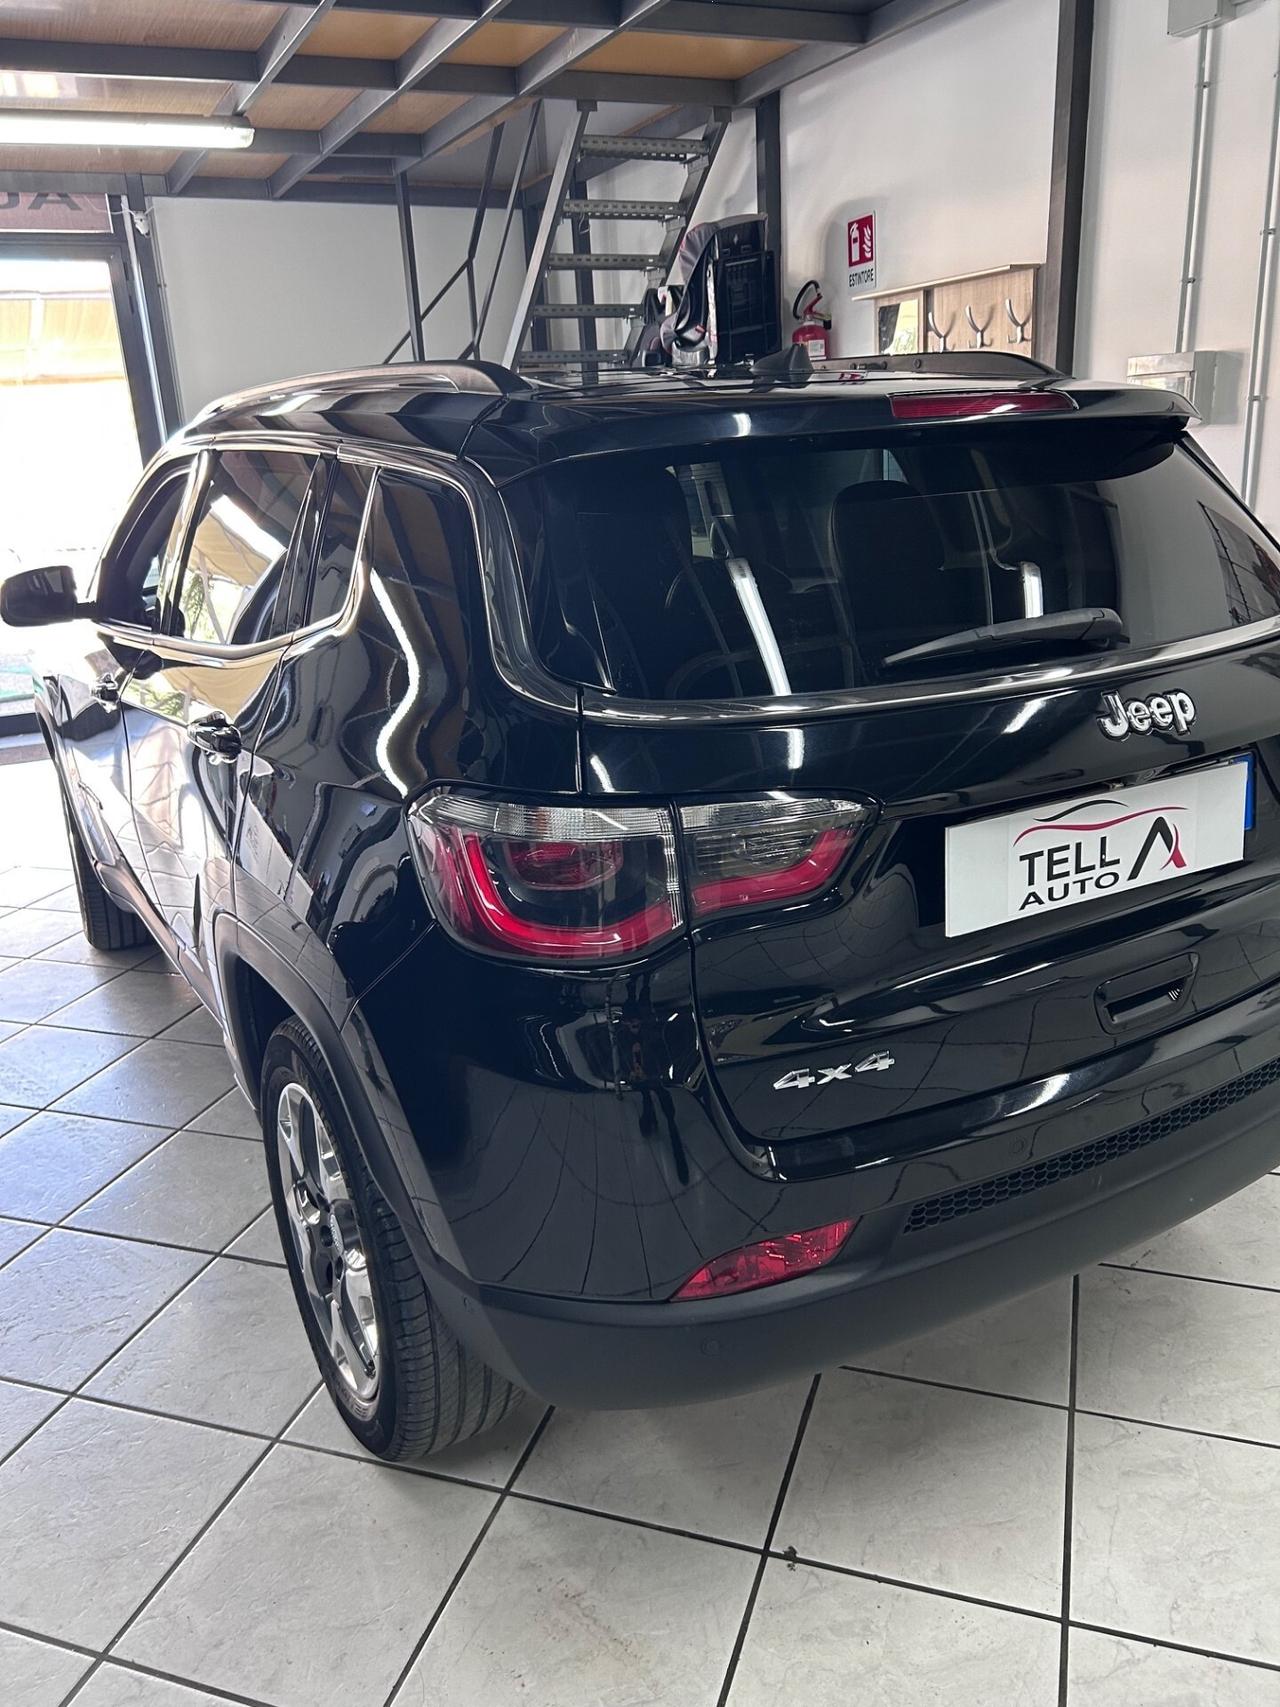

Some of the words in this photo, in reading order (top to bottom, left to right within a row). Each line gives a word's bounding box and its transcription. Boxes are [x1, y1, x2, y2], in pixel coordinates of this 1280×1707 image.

[849, 268, 874, 287] ESTINTORE
[1097, 689, 1197, 740] Jeep
[1018, 871, 1120, 911] AUTO
